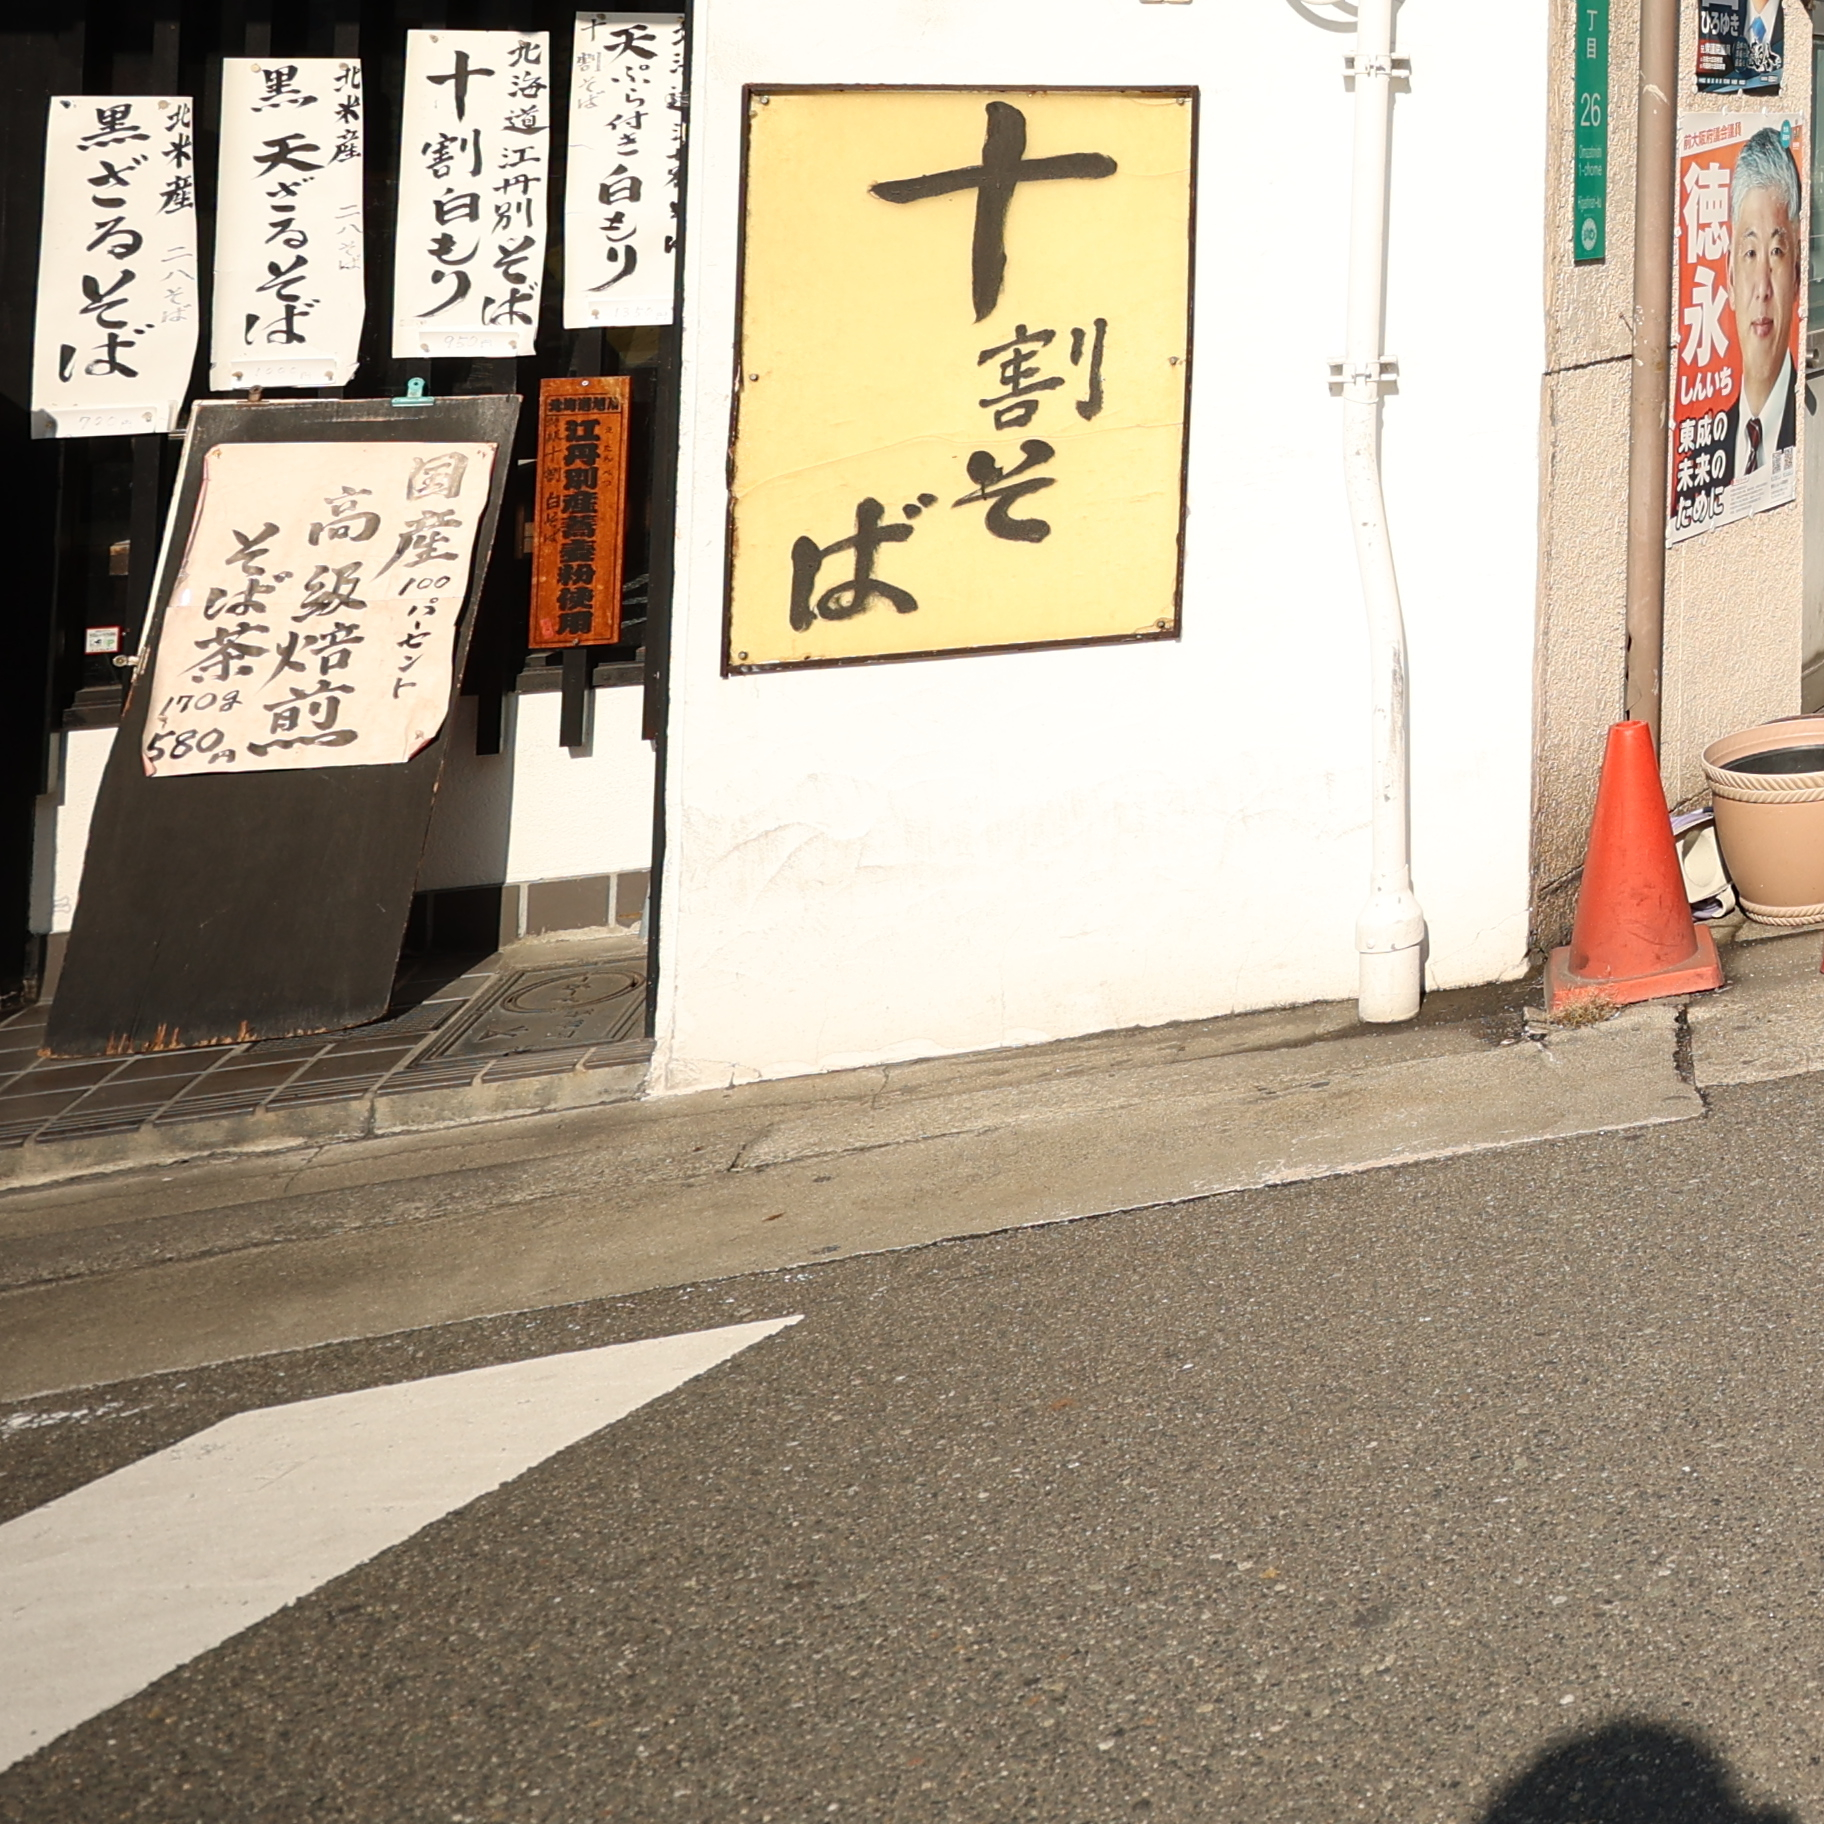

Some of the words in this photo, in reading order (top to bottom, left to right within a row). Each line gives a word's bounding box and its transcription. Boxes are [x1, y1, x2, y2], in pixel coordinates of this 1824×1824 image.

[1701, 11, 1740, 37] ひろゆき
[156, 103, 194, 215] 北米産
[325, 67, 362, 167] 北米産
[586, 24, 659, 293] 天ぷら付き白もり
[1580, 92, 1602, 127] 26
[245, 65, 325, 346] 黒天ざるそば
[413, 50, 495, 318] 十割白もり
[59, 103, 155, 383] 黒ざるそば
[1683, 161, 1732, 366] 徳永
[789, 100, 1118, 632] 十割そば
[1680, 366, 1732, 405] しんいち
[1677, 449, 1727, 493] 未来の
[1678, 412, 1728, 454] 東成の
[1675, 486, 1725, 531] ために
[177, 522, 294, 683] そば茶
[247, 485, 381, 757] 高級焙煎
[147, 727, 236, 764] 580円
[159, 690, 243, 717] 170g
